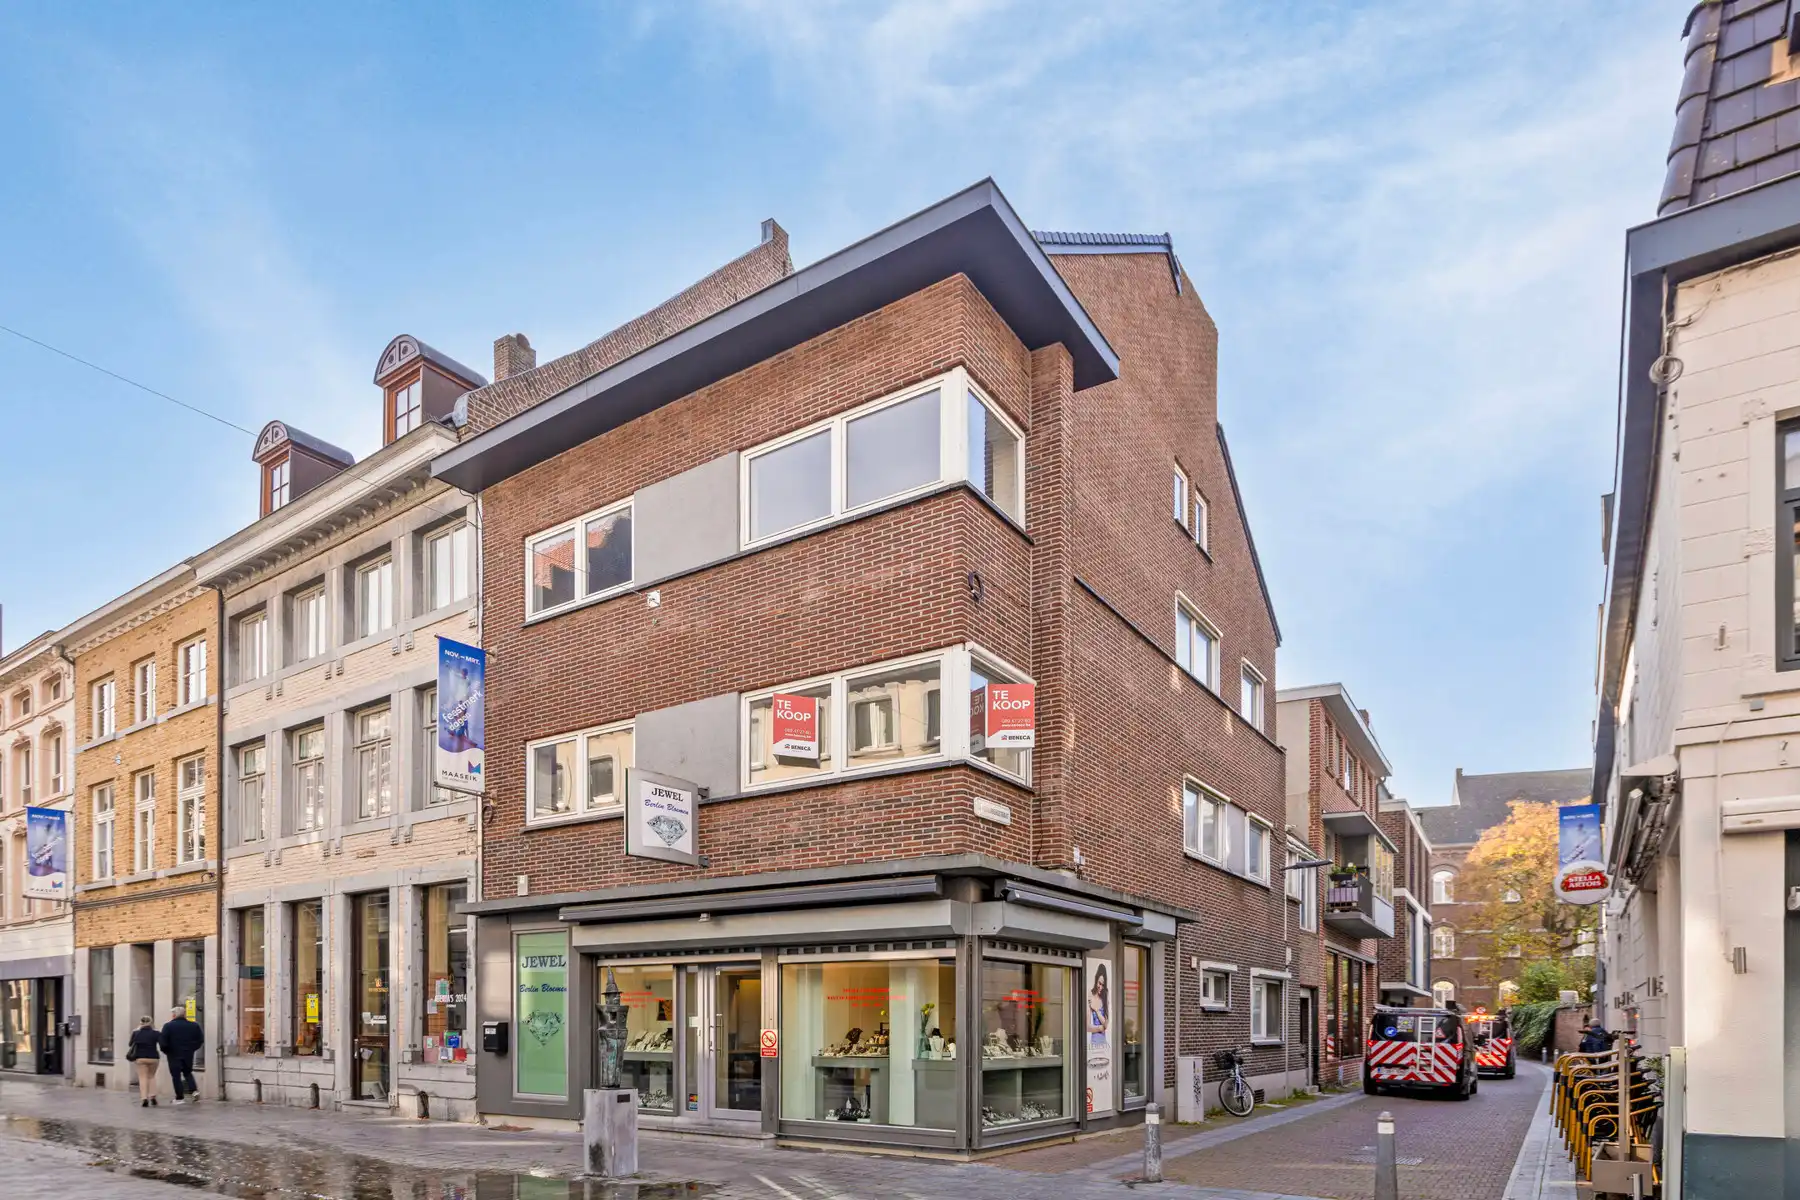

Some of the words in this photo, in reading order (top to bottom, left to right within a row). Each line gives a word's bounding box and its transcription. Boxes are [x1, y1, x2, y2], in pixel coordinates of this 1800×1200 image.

[444, 649, 459, 659] NOV.
[465, 655, 480, 665] MRT.
[992, 690, 1009, 700] TE
[776, 699, 791, 710] TE
[992, 700, 1031, 710] KOOP
[776, 709, 812, 722] KOOP
[791, 744, 811, 752] BENECA
[441, 770, 478, 782] MAASEIK
[651, 787, 684, 802] JEWEL
[644, 799, 665, 809] Berlin
[1568, 874, 1600, 883] STELLA
[521, 954, 567, 968] JEWEL
[519, 984, 539, 992] Berlin
[541, 983, 568, 992] Bloemen
